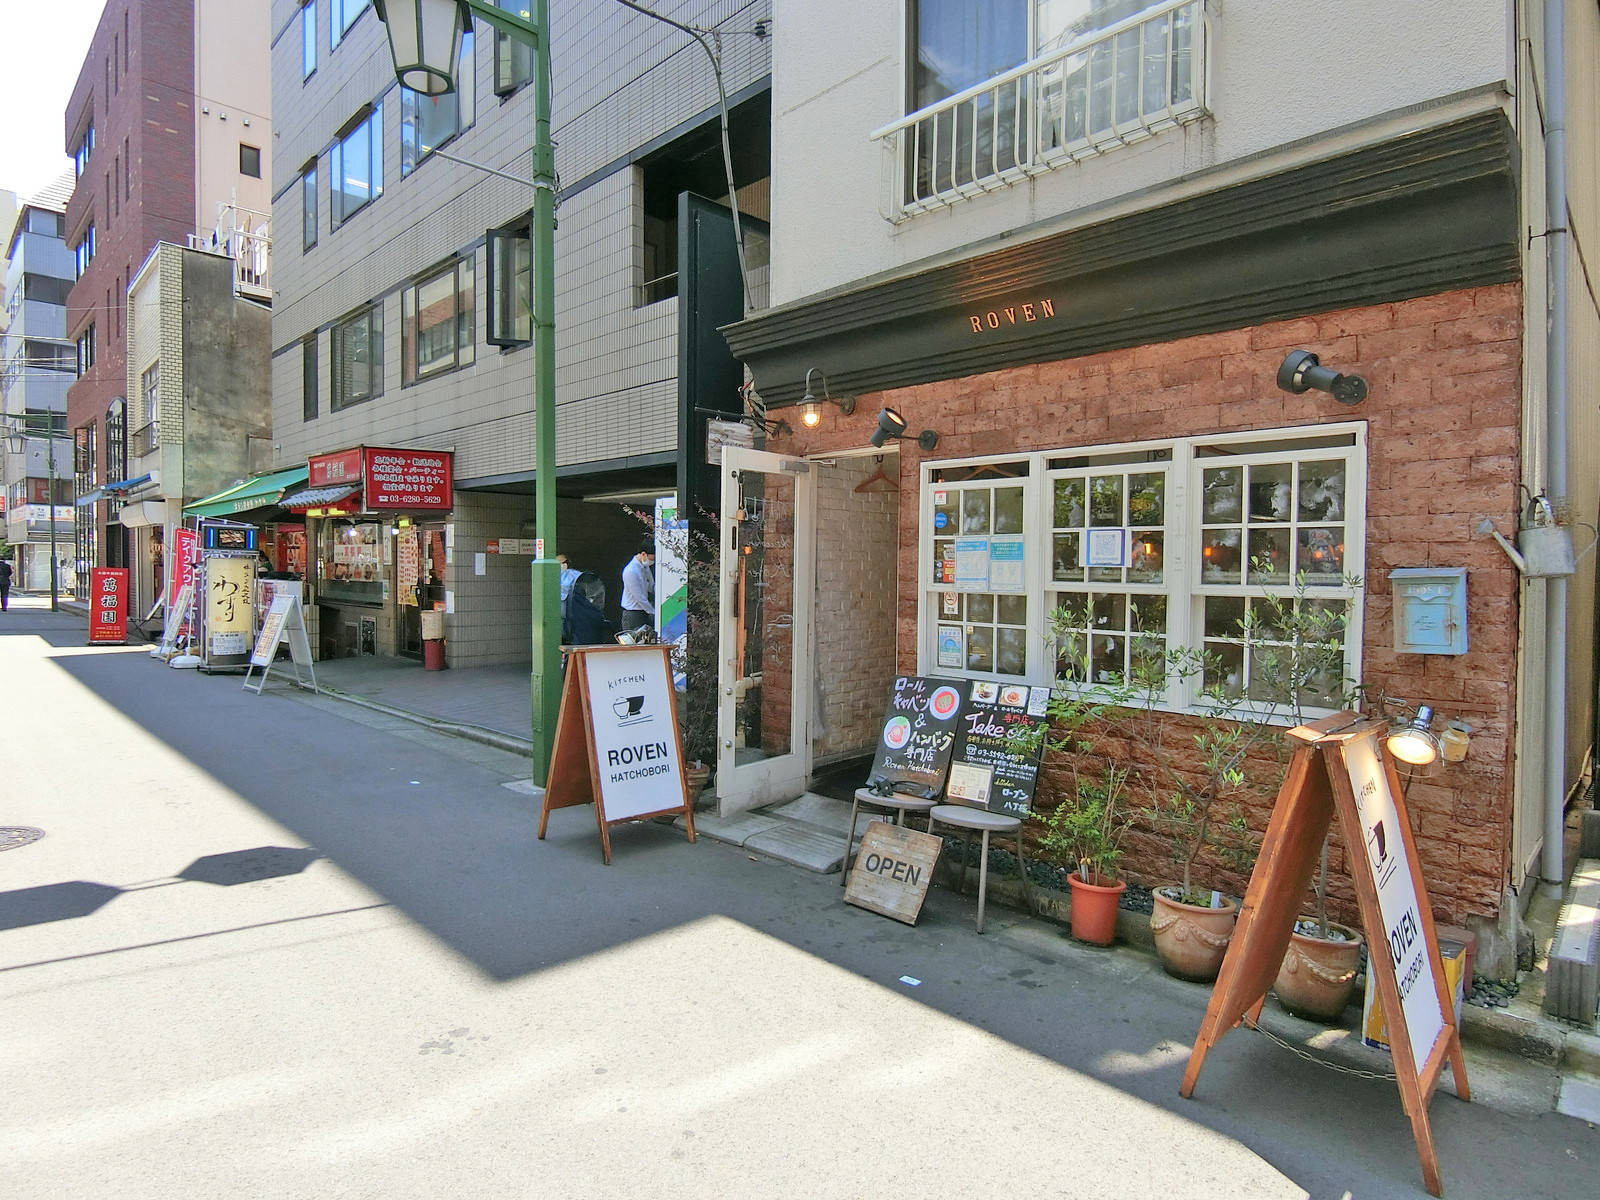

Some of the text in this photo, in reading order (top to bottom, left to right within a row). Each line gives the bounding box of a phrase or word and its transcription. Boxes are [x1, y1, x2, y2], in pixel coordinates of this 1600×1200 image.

[969, 299, 1055, 333] ROVEN
[389, 495, 441, 503] 03-6280-5629
[181, 537, 192, 586] テイクアウ
[101, 577, 118, 624] 萬福園
[608, 674, 645, 690] KITCHEN
[895, 677, 926, 692] ロール
[893, 692, 931, 712] キャベツ
[915, 712, 926, 727] &
[965, 711, 1004, 738] Take
[909, 730, 955, 752] ハンバーグ
[607, 742, 668, 766] ROVEN
[903, 744, 937, 762] 専門店
[610, 764, 670, 783] HATCHOBORI
[865, 853, 922, 886] OPEN
[1387, 906, 1418, 970] OVEN
